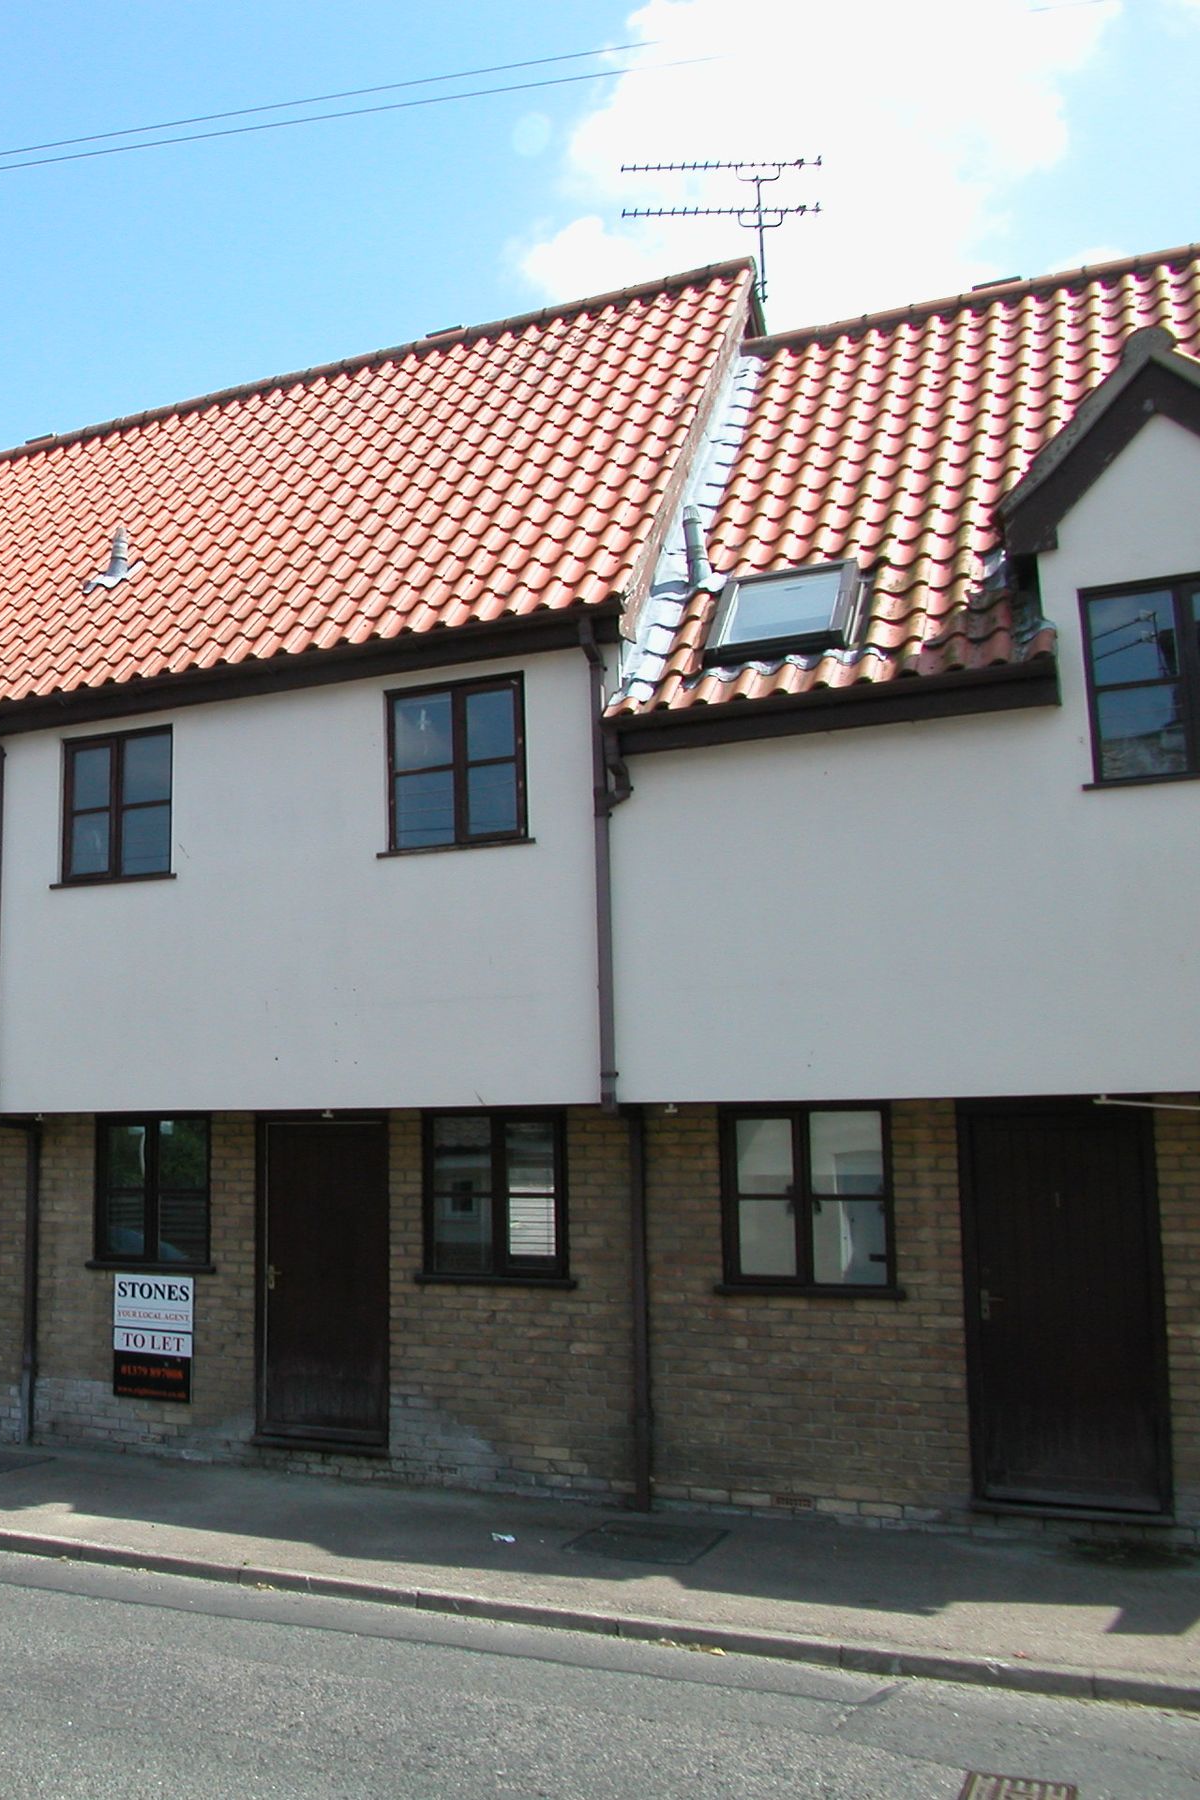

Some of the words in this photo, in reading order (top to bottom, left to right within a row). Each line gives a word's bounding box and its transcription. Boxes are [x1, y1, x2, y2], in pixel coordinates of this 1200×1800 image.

[117, 1281, 189, 1302] STONES
[117, 1310, 137, 1318] YOUR
[138, 1311, 161, 1319] LOCAL
[164, 1313, 189, 1321] AGENT
[123, 1332, 145, 1348] TO
[150, 1335, 184, 1352] LET
